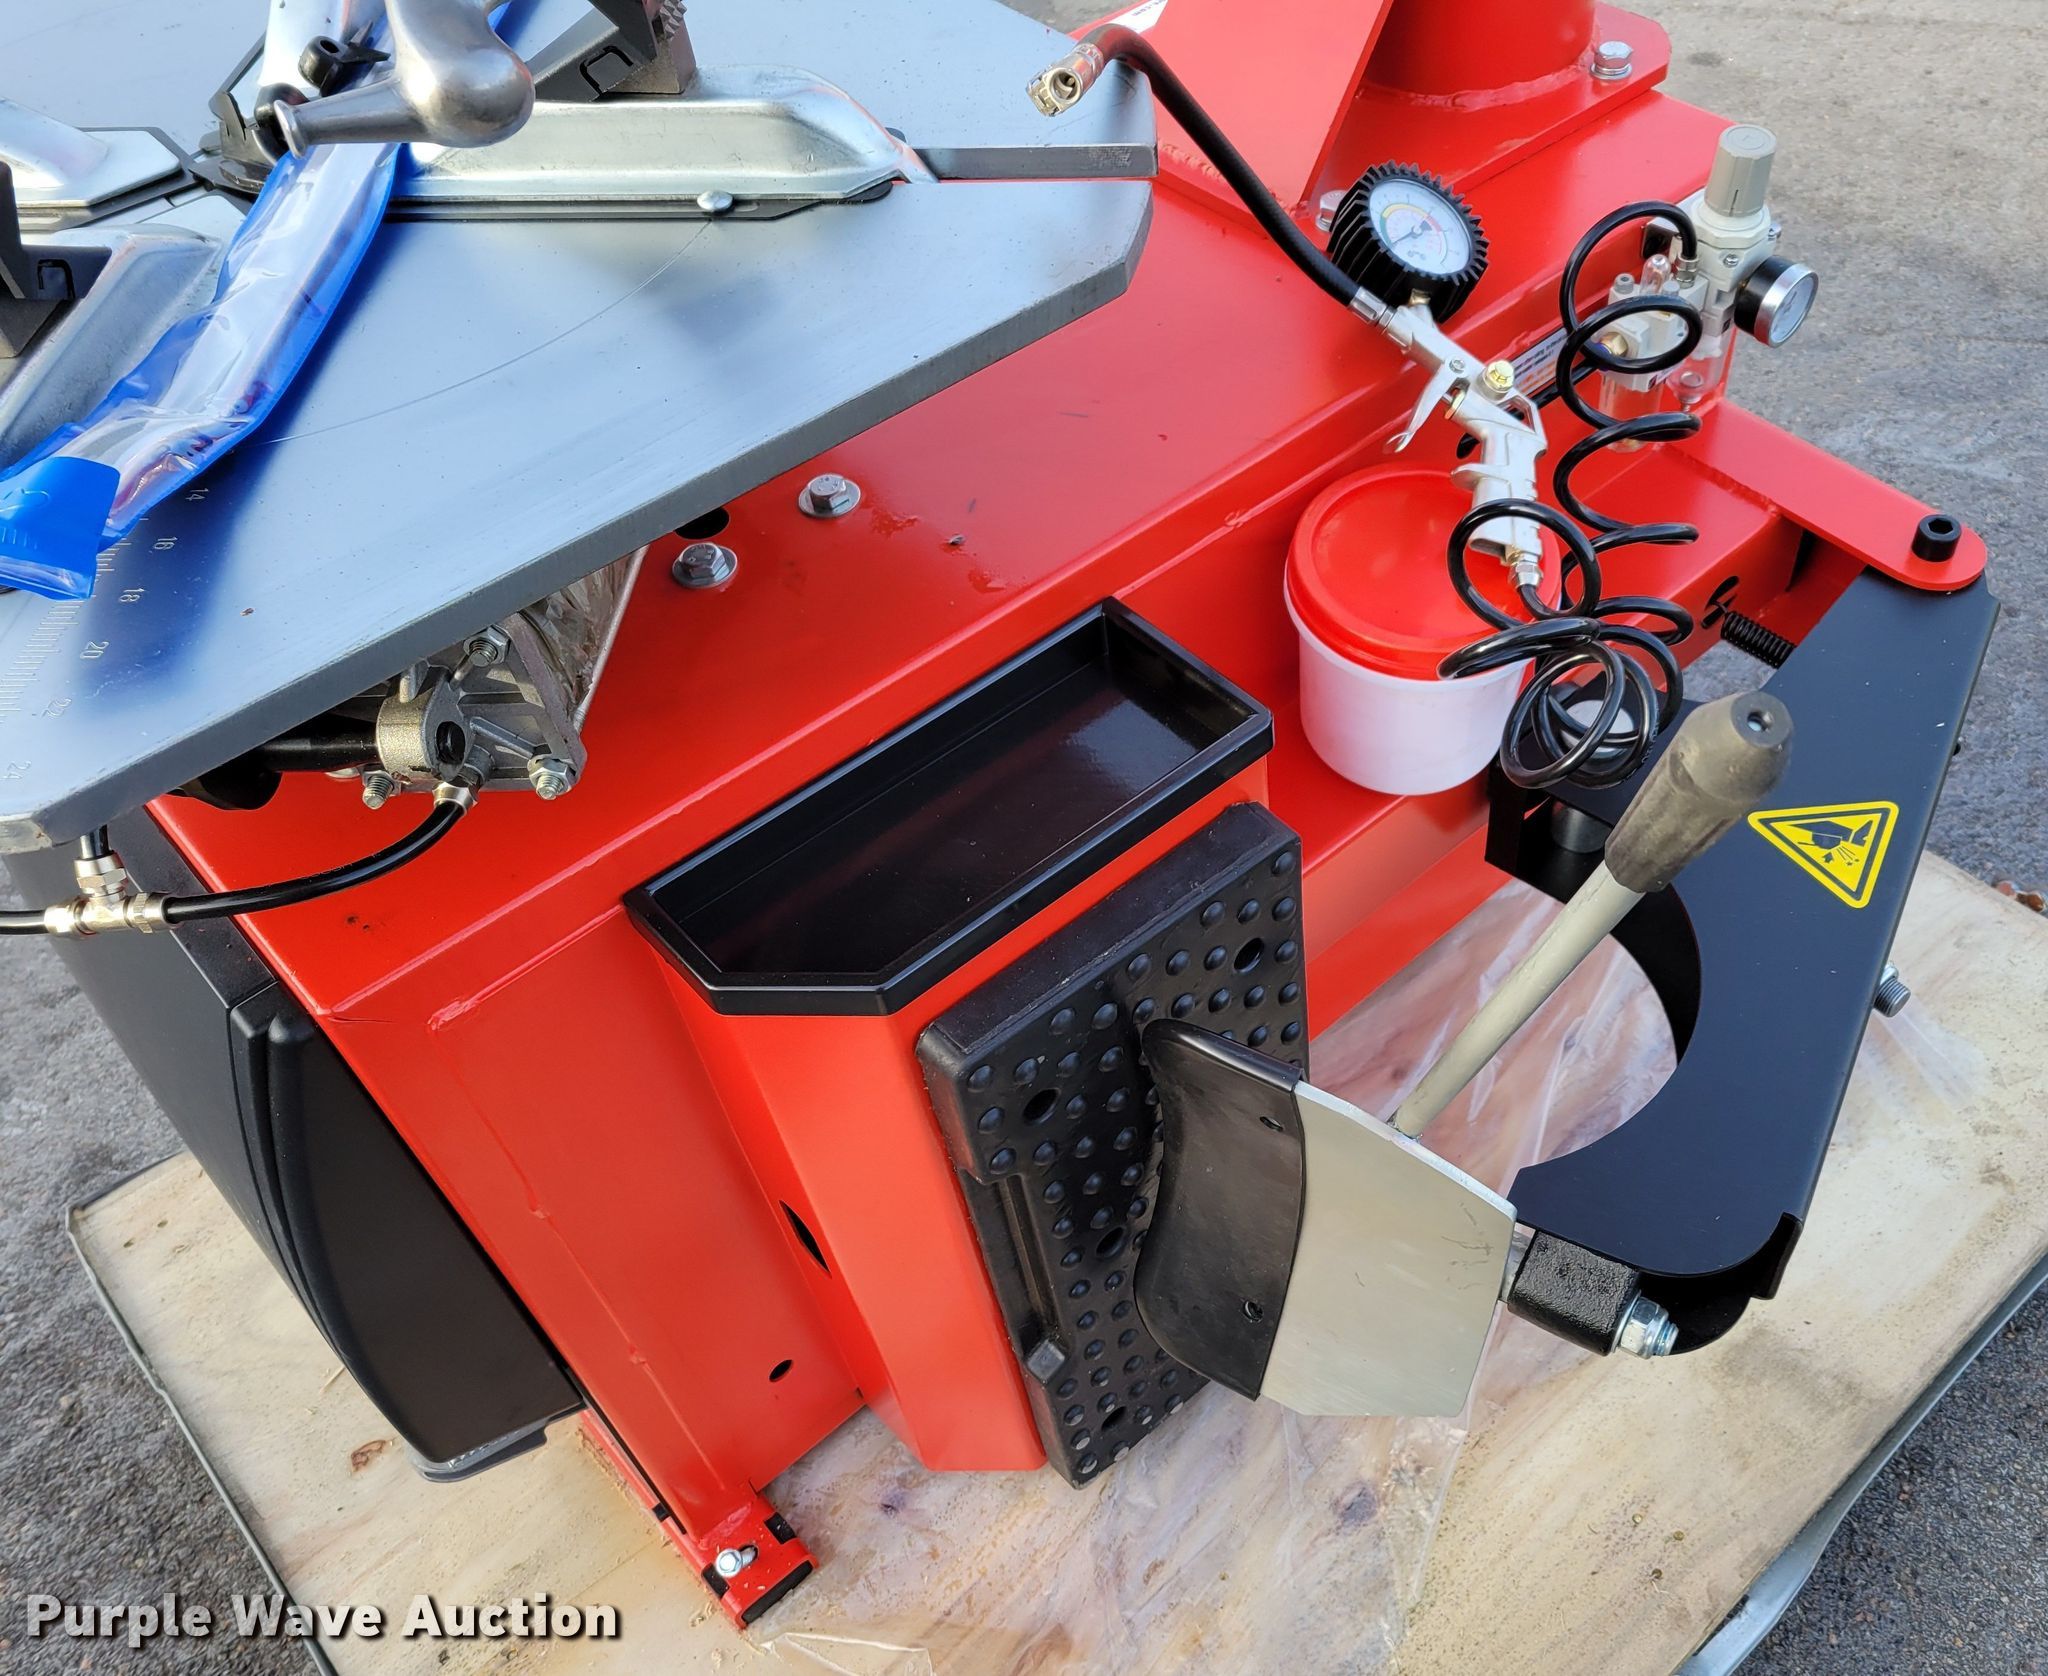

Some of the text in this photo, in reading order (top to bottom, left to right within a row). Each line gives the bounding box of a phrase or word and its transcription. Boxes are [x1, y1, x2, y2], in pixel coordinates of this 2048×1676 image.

[185, 487, 210, 501] 14
[152, 536, 179, 551] 16
[118, 587, 146, 603] 18
[79, 641, 110, 660] 20
[42, 698, 72, 719] 22
